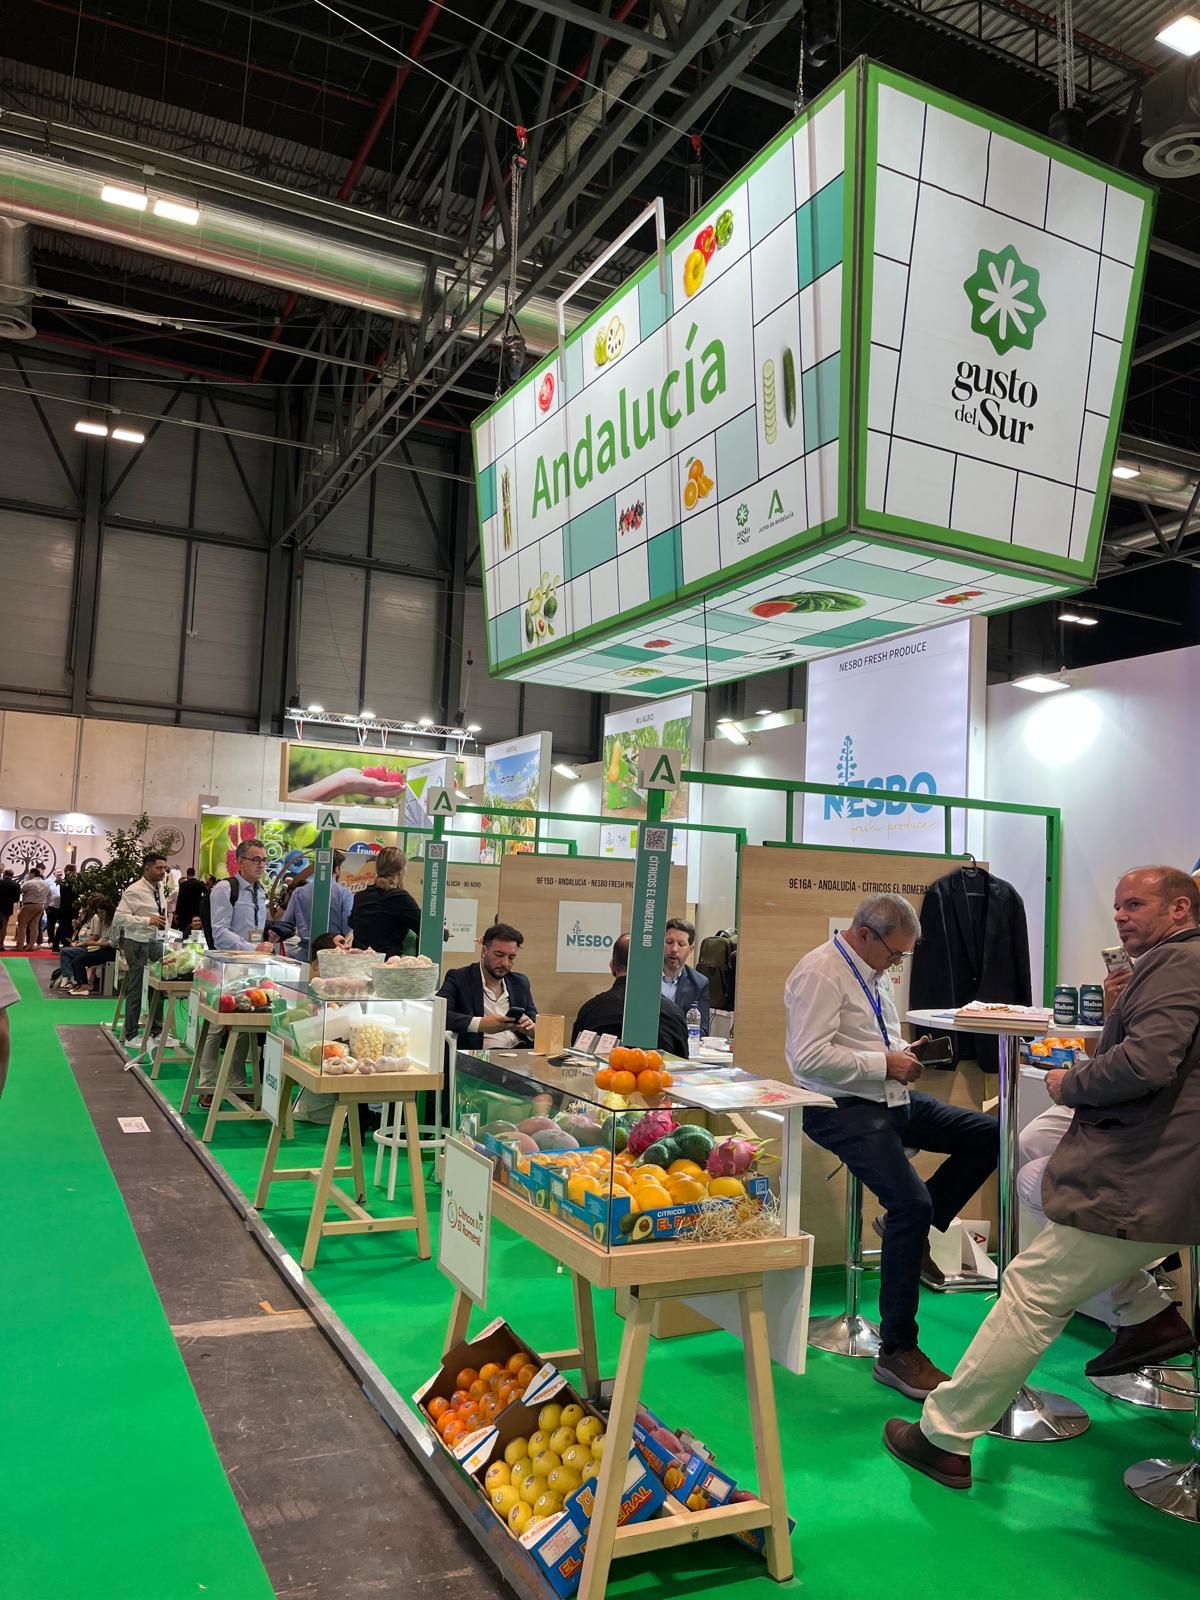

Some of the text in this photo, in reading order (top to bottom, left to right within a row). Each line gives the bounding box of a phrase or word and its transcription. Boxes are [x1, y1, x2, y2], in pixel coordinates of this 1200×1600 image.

[951, 361, 1038, 408] gusto
[532, 322, 727, 519] Andalucía
[954, 398, 1034, 445] del Sur
[839, 641, 927, 673] NESBO FRESH PRODUCE
[824, 772, 937, 820] NESBO
[49, 820, 96, 835] Export
[558, 878, 587, 886] ANDALUCÍA
[591, 879, 608, 888] NESBO
[609, 880, 625, 888] FRESH
[789, 878, 812, 890] 9E16A
[818, 879, 856, 892] ANDALUCÍA
[862, 880, 892, 893] CÍTRICOS
[893, 883, 900, 894] EL
[902, 884, 929, 895] ROMERA
[643, 899, 656, 934] ROMERAL
[566, 934, 613, 948] NESBO
[642, 935, 652, 948] BIO
[657, 1217, 672, 1231] EL
[559, 1556, 582, 1579] EL
